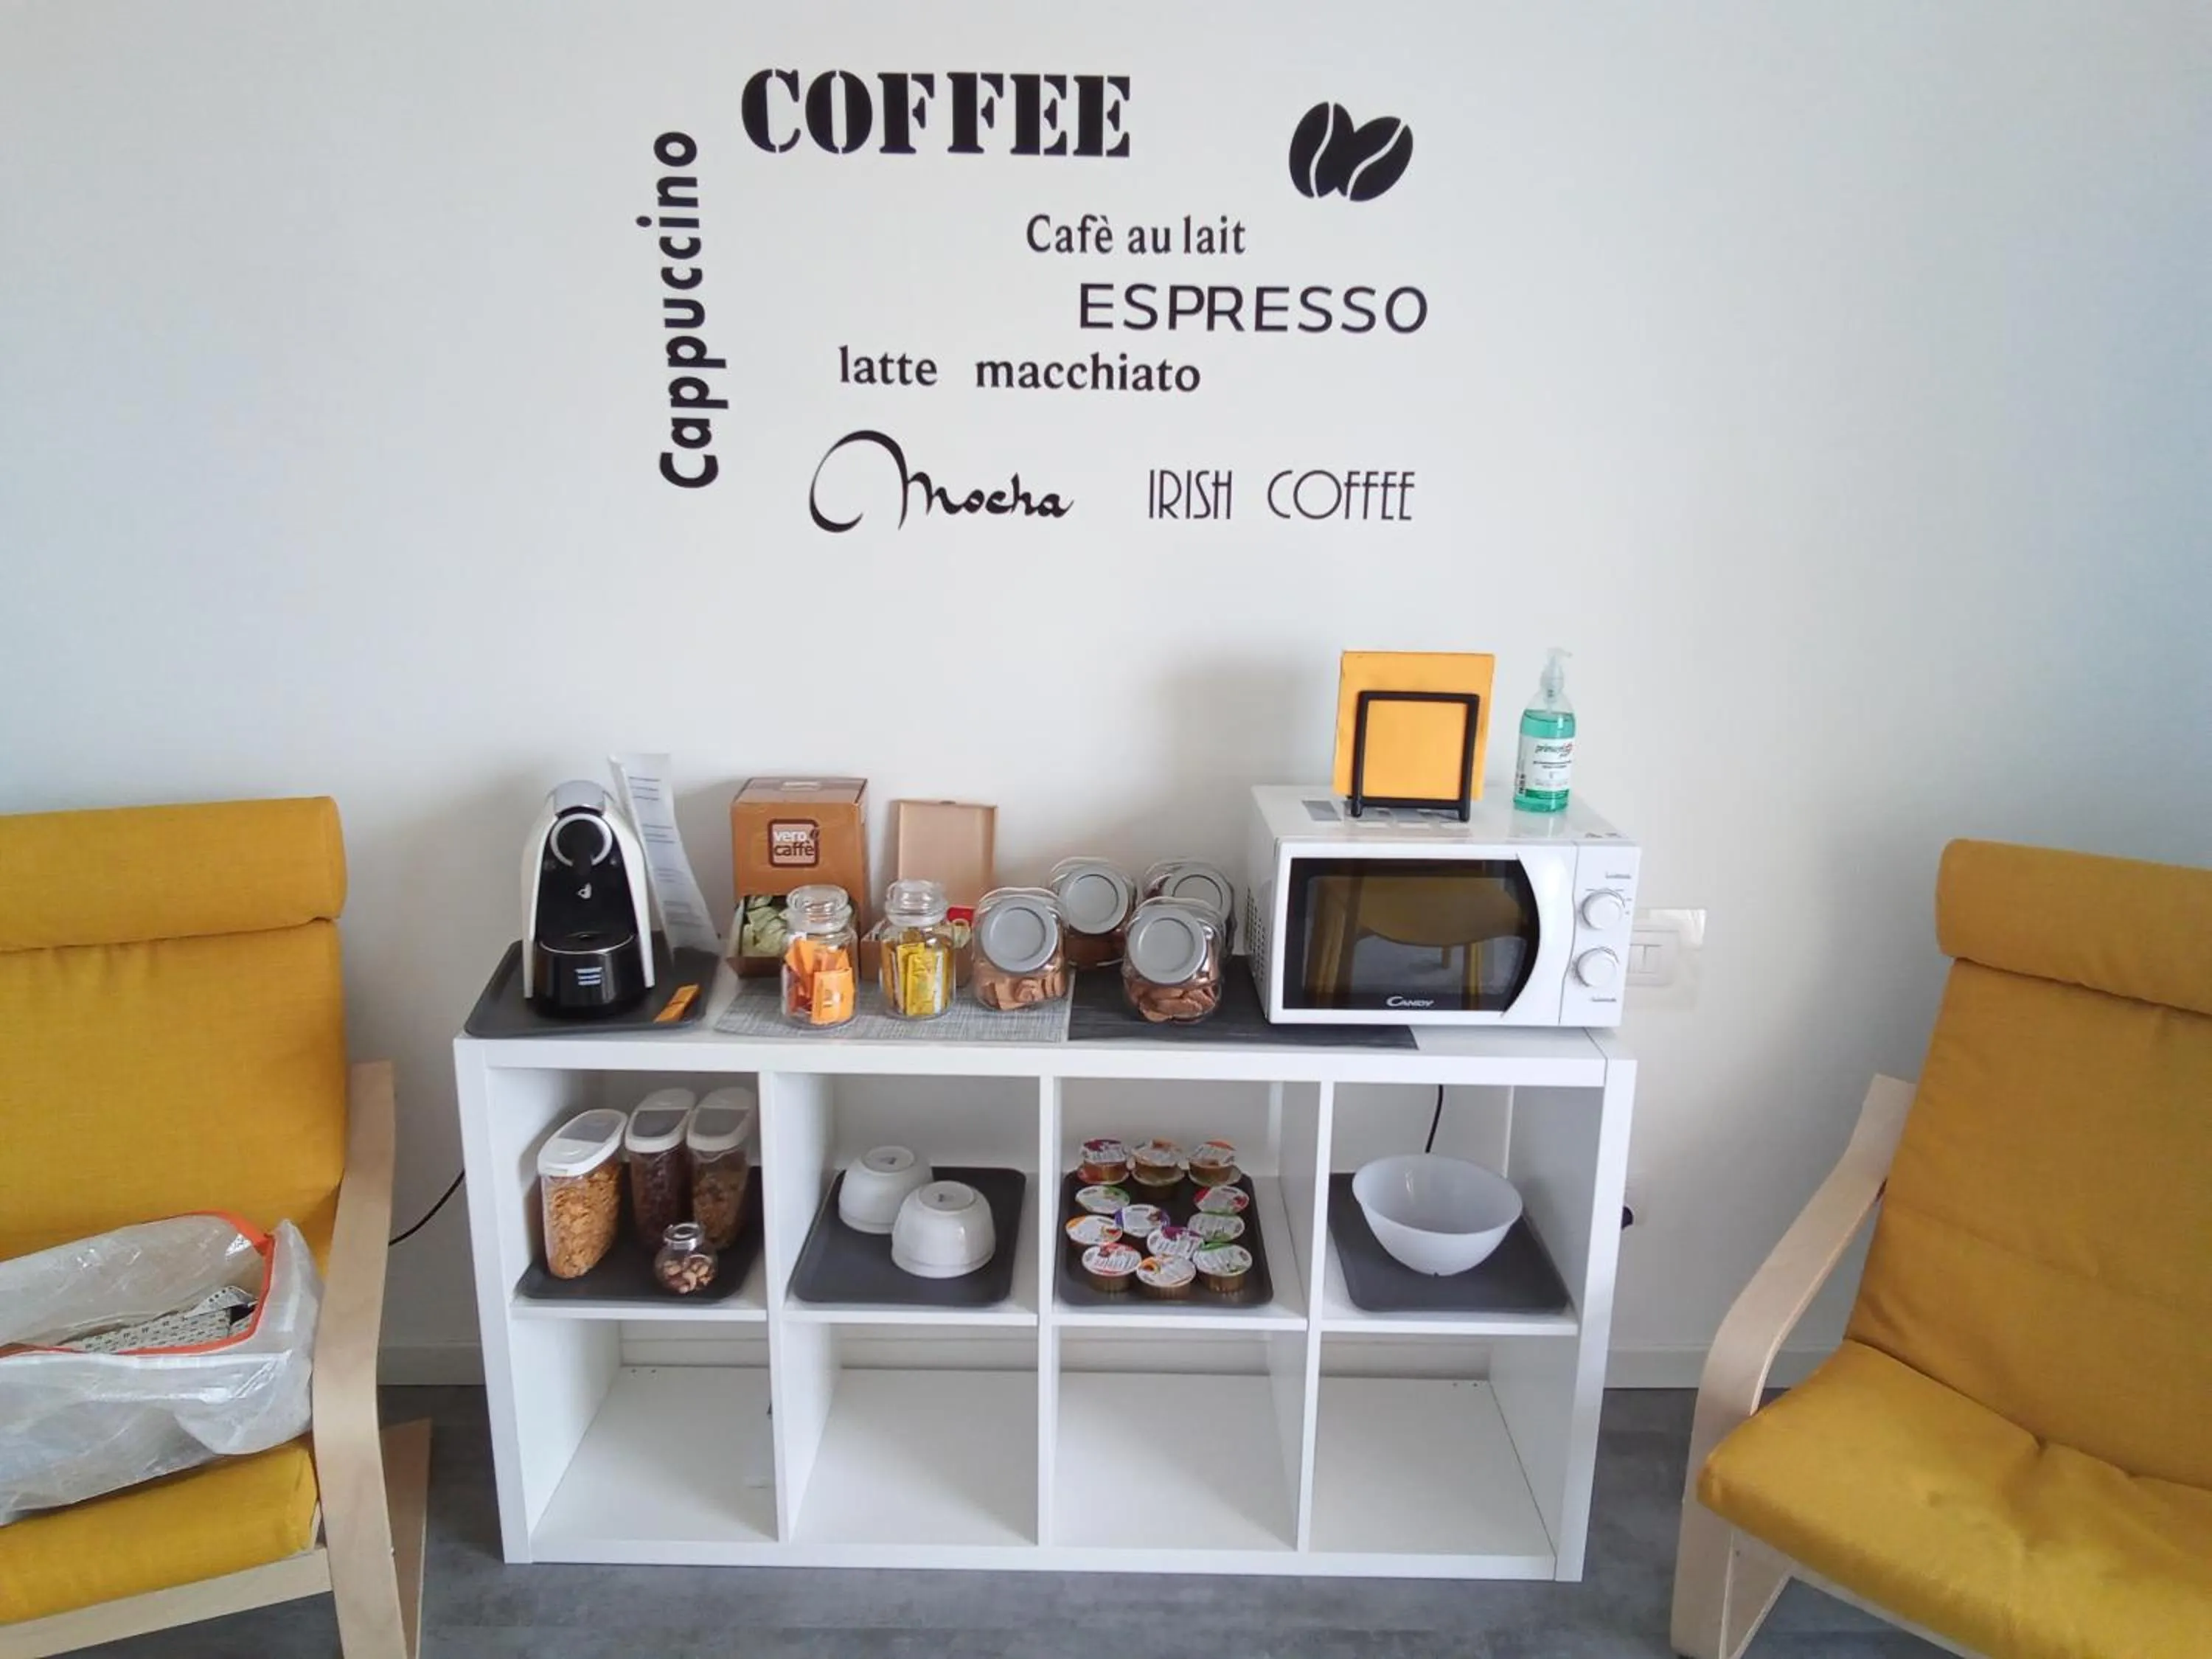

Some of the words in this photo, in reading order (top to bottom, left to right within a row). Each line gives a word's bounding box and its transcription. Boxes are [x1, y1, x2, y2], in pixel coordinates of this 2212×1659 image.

[741, 69, 1130, 158] COFFEE
[1026, 214, 1113, 254] Cafè
[1128, 226, 1171, 254] au
[1183, 215, 1246, 254] lait
[636, 131, 728, 489] Cappuccino
[1080, 282, 1427, 333] ESPRESSO
[839, 345, 937, 386] latte
[975, 352, 1200, 392] macchiato
[1149, 470, 1232, 520] IRISH
[1267, 470, 1415, 521] COFFEE
[773, 830, 807, 841] vero
